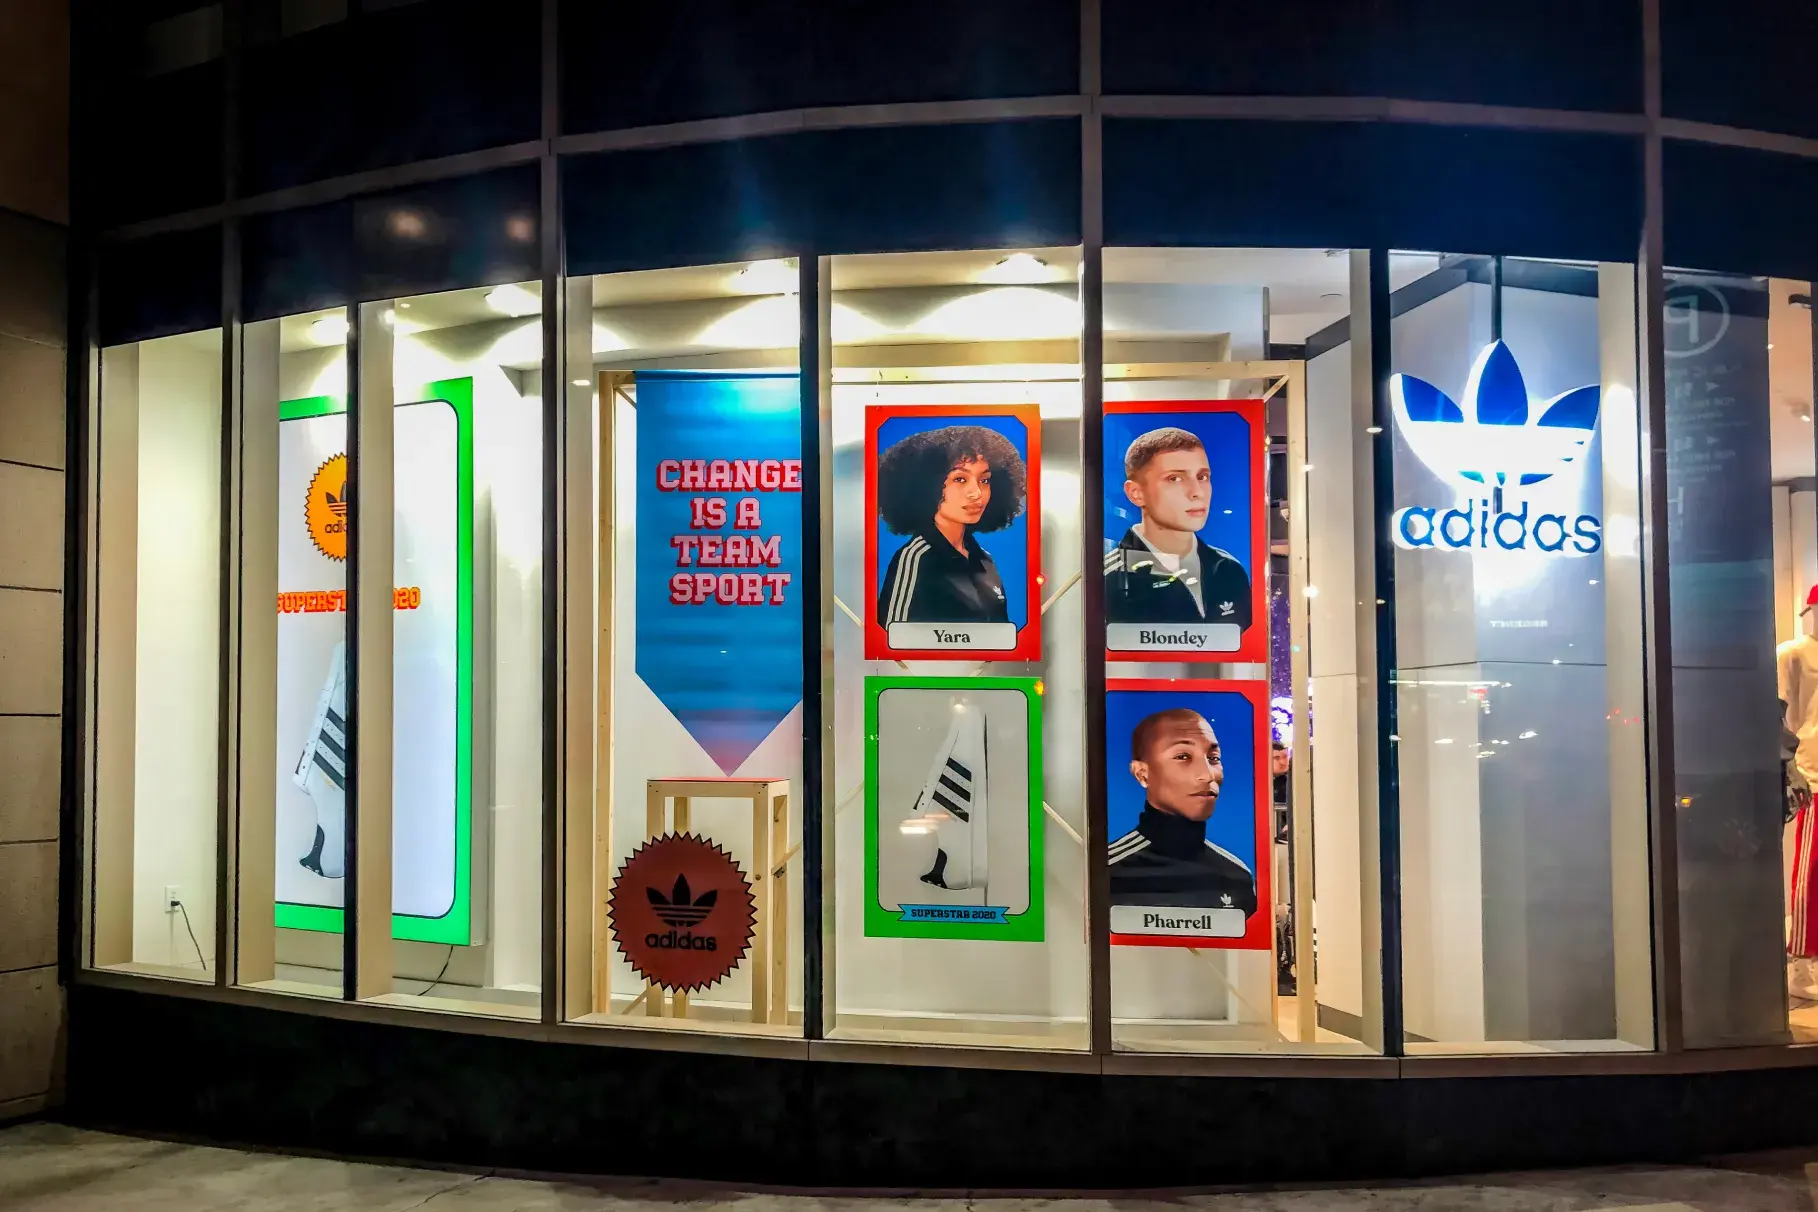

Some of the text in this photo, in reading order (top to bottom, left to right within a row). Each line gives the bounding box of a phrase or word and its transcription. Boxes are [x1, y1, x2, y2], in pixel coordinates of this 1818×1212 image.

[656, 459, 802, 492] CHANGE
[690, 496, 762, 530] IS A
[1398, 498, 1602, 554] adidas
[670, 534, 782, 568] TEAM
[669, 572, 791, 606] SPORT
[933, 629, 971, 643] Yara
[1139, 630, 1208, 648] Blondey
[911, 909, 996, 919] SUPERSTAR 2020
[1143, 913, 1212, 930] Pharrell
[645, 931, 717, 952] adidas
